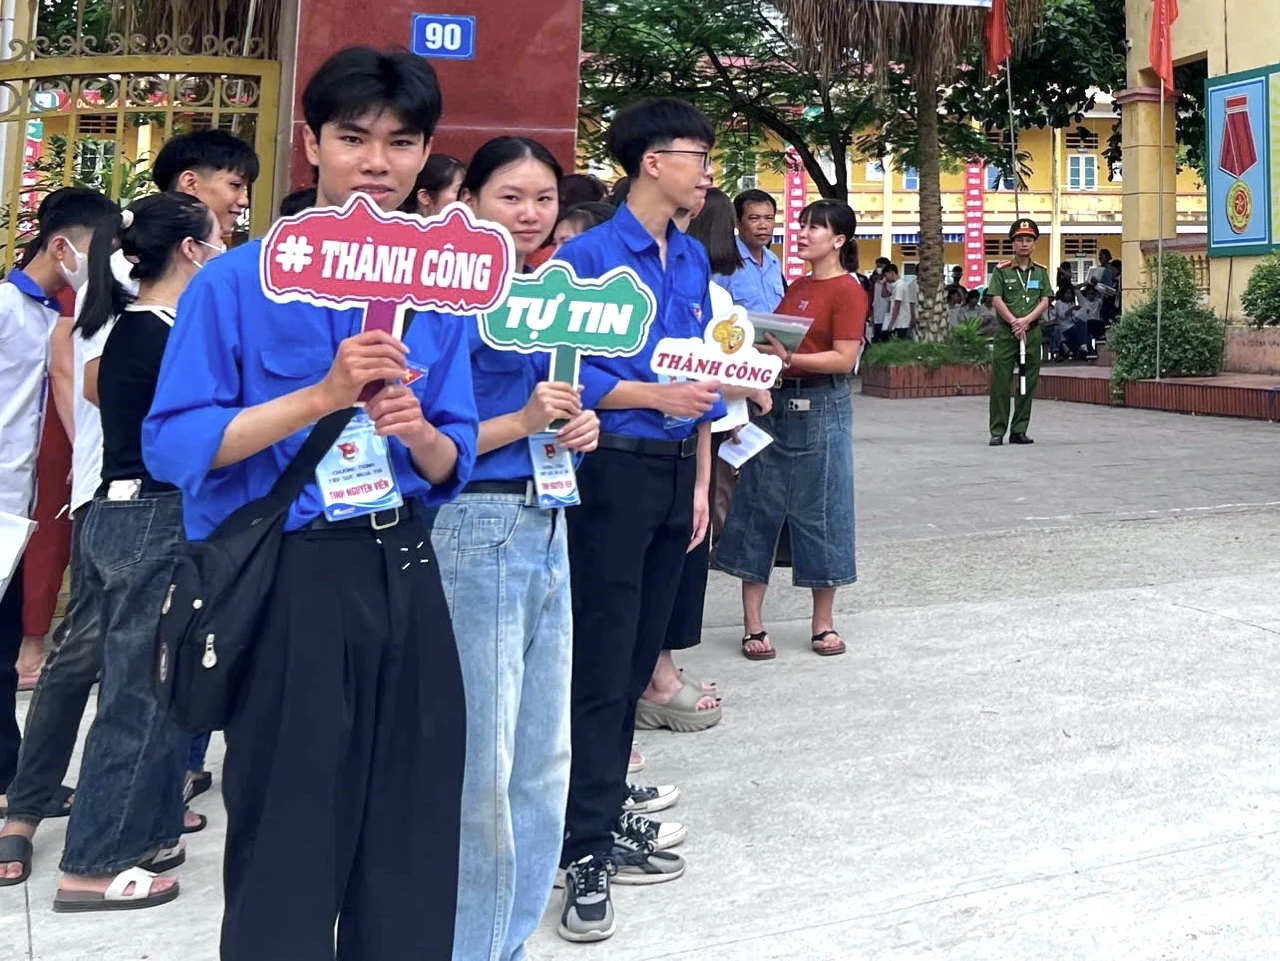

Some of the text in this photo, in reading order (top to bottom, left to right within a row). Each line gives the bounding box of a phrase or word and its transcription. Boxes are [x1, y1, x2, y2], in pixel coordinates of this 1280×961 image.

[425, 22, 461, 51] 90
[275, 235, 493, 291] # THÀNH CÔNG
[505, 292, 634, 340] TỰ TIN
[656, 353, 773, 383] THÀNH CÔNG
